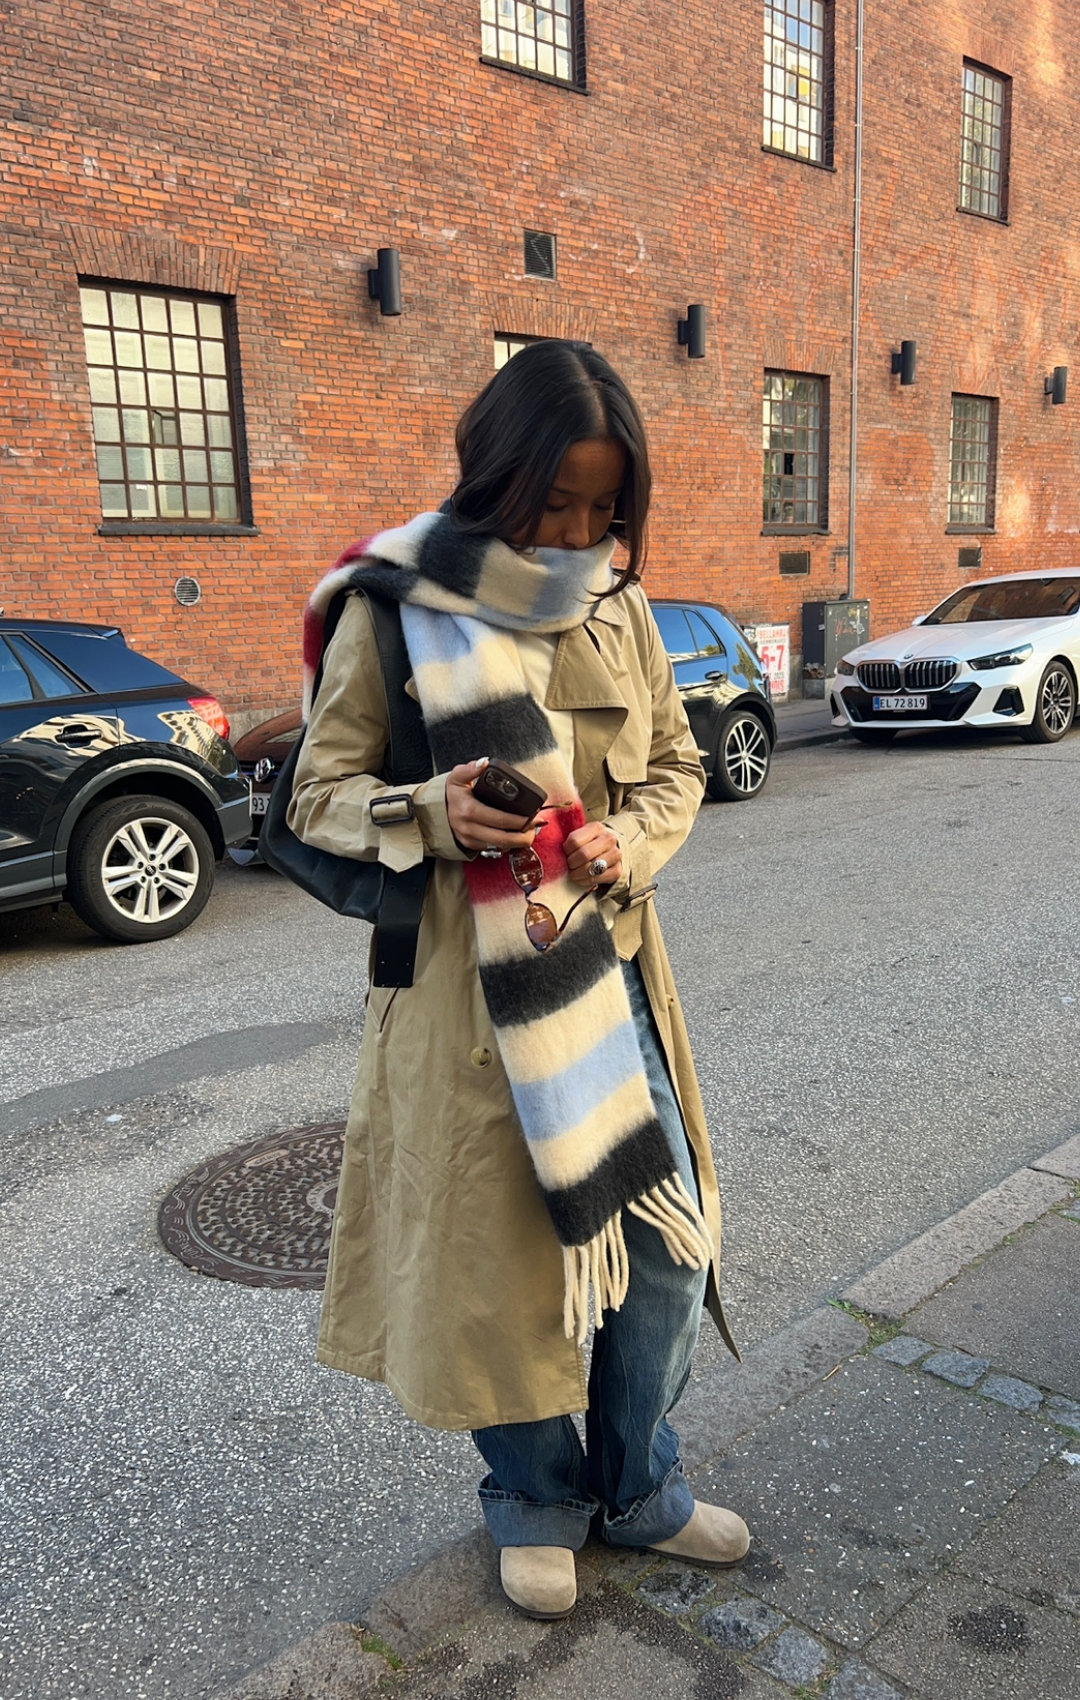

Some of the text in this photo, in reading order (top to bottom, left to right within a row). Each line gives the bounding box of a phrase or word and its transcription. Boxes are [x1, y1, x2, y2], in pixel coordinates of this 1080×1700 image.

[880, 698, 925, 708] EL 72 819
